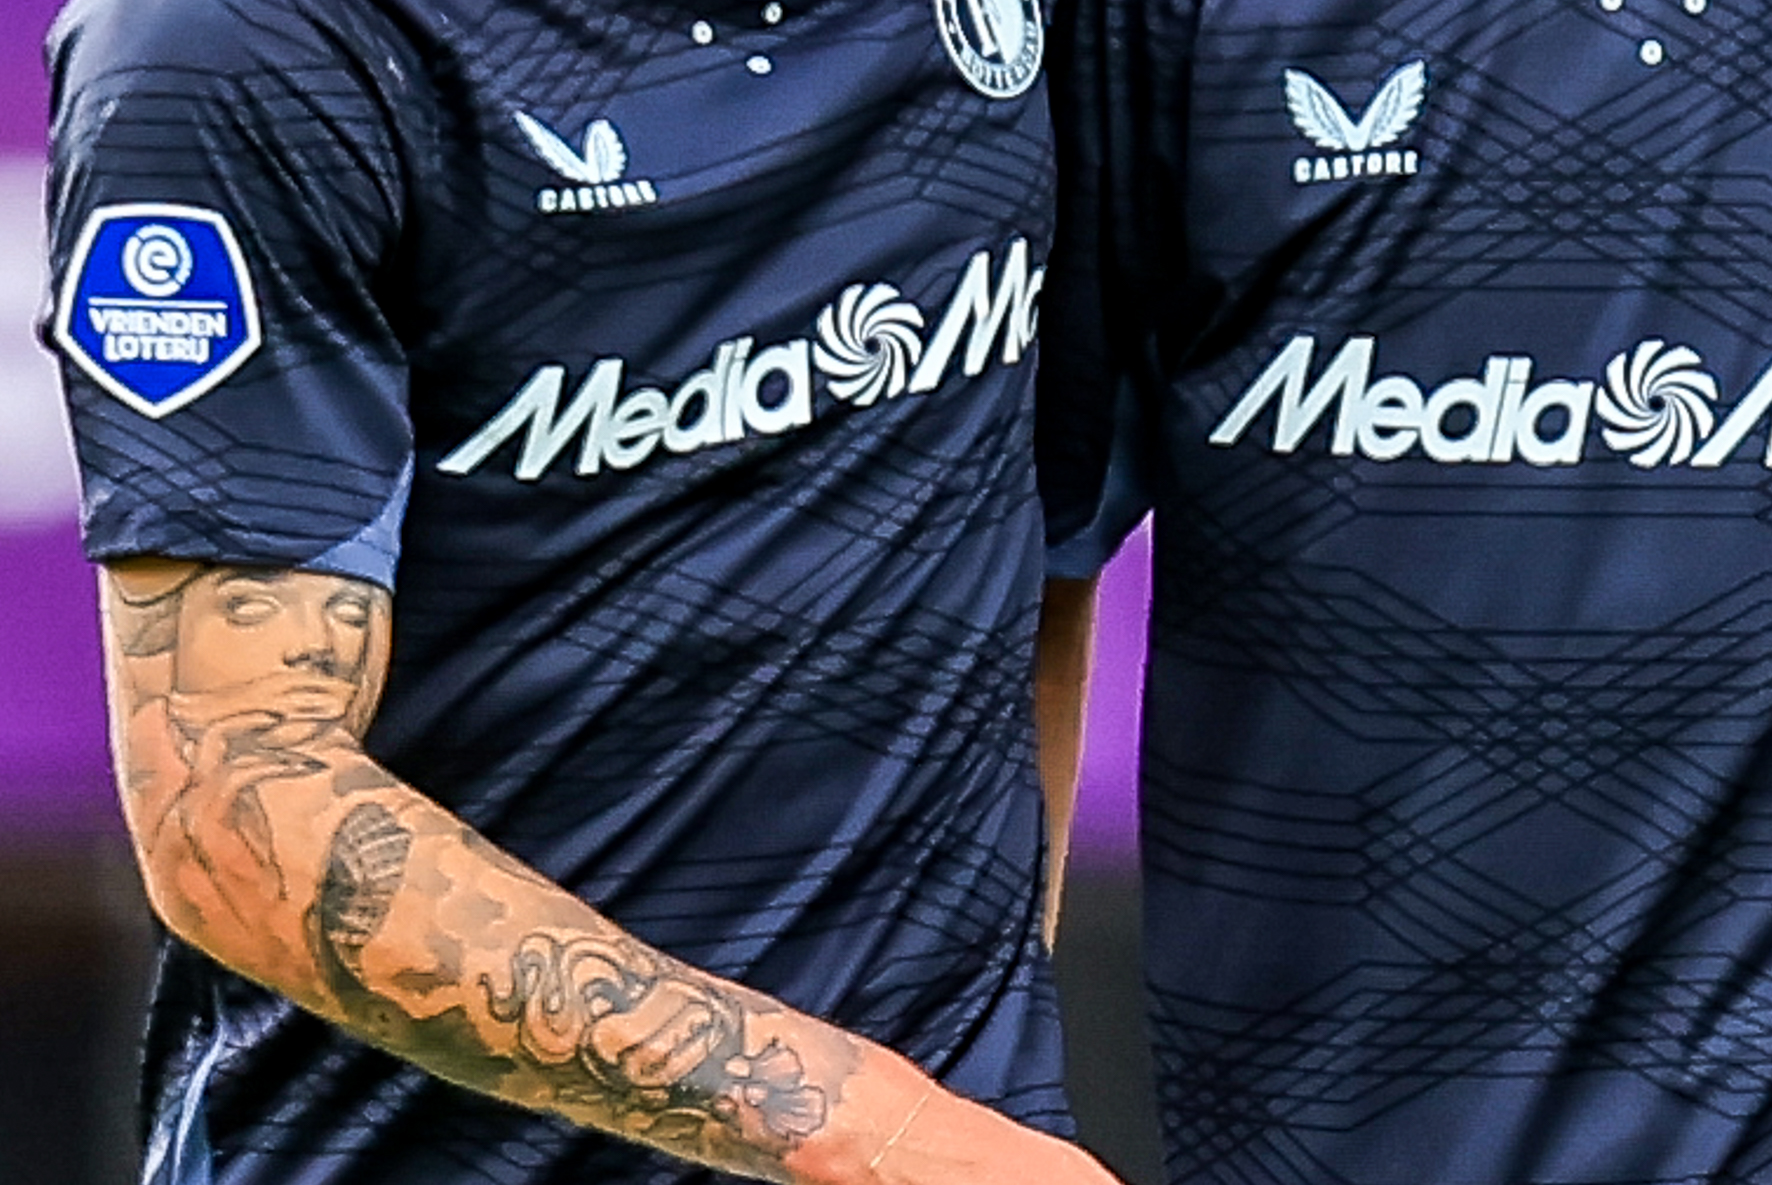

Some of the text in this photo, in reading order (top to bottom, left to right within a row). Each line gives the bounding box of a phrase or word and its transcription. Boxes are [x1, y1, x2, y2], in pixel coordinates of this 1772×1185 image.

[1294, 150, 1418, 183] CASTORE
[88, 307, 227, 337] VRIENDEN
[437, 337, 812, 480] Media
[1209, 336, 1595, 465] Media
